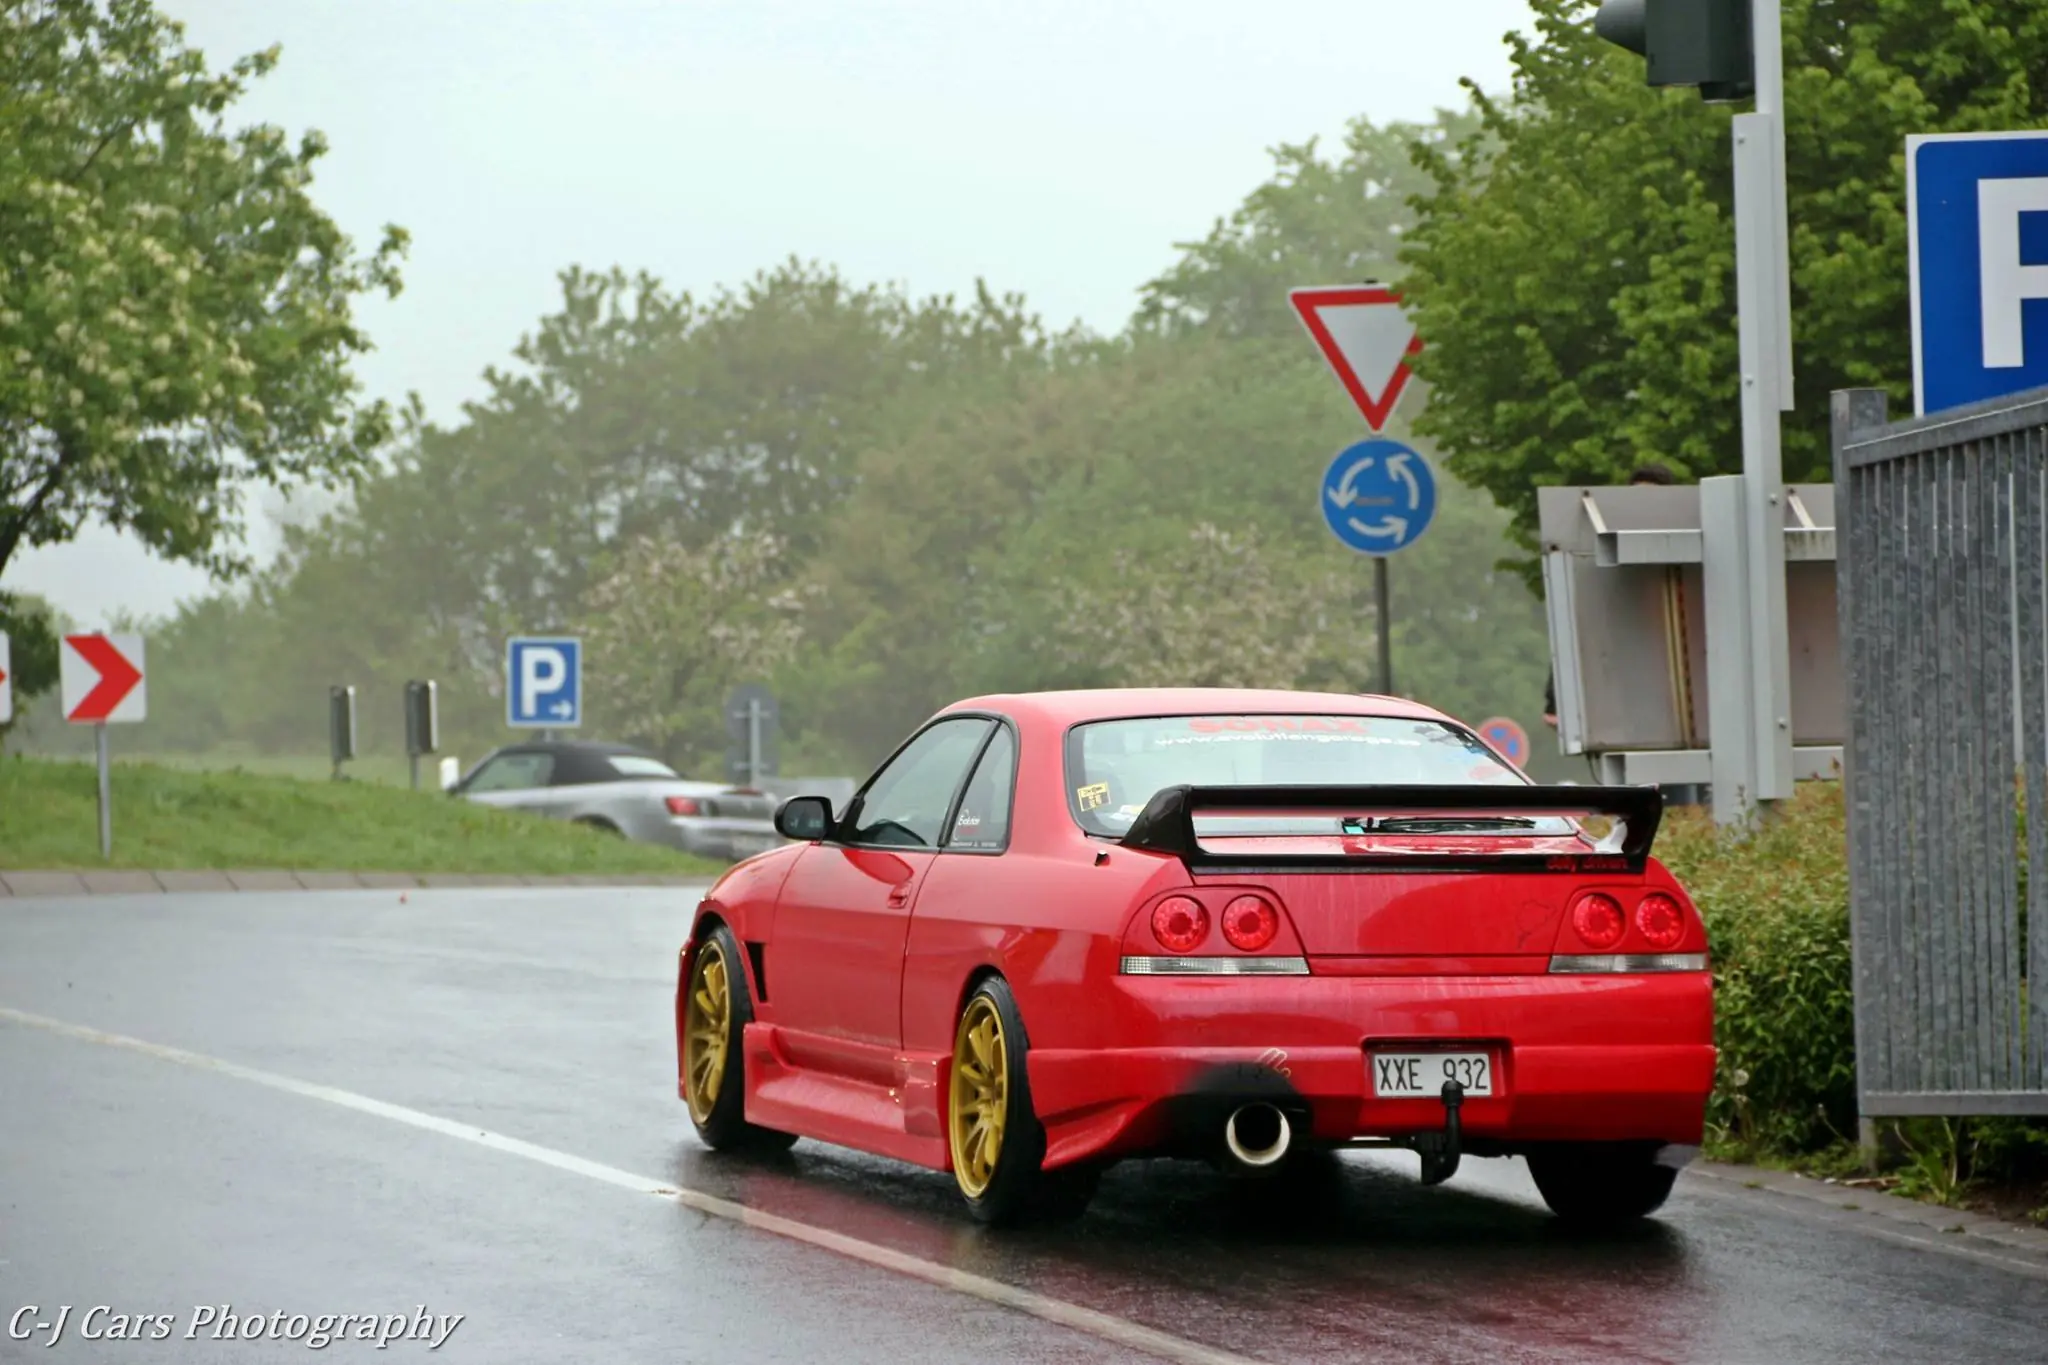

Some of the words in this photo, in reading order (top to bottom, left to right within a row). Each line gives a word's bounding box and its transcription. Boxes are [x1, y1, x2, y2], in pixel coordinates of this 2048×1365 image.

[521, 646, 566, 717] P
[1378, 1058, 1423, 1090] XXE
[1443, 1058, 1488, 1090] 932
